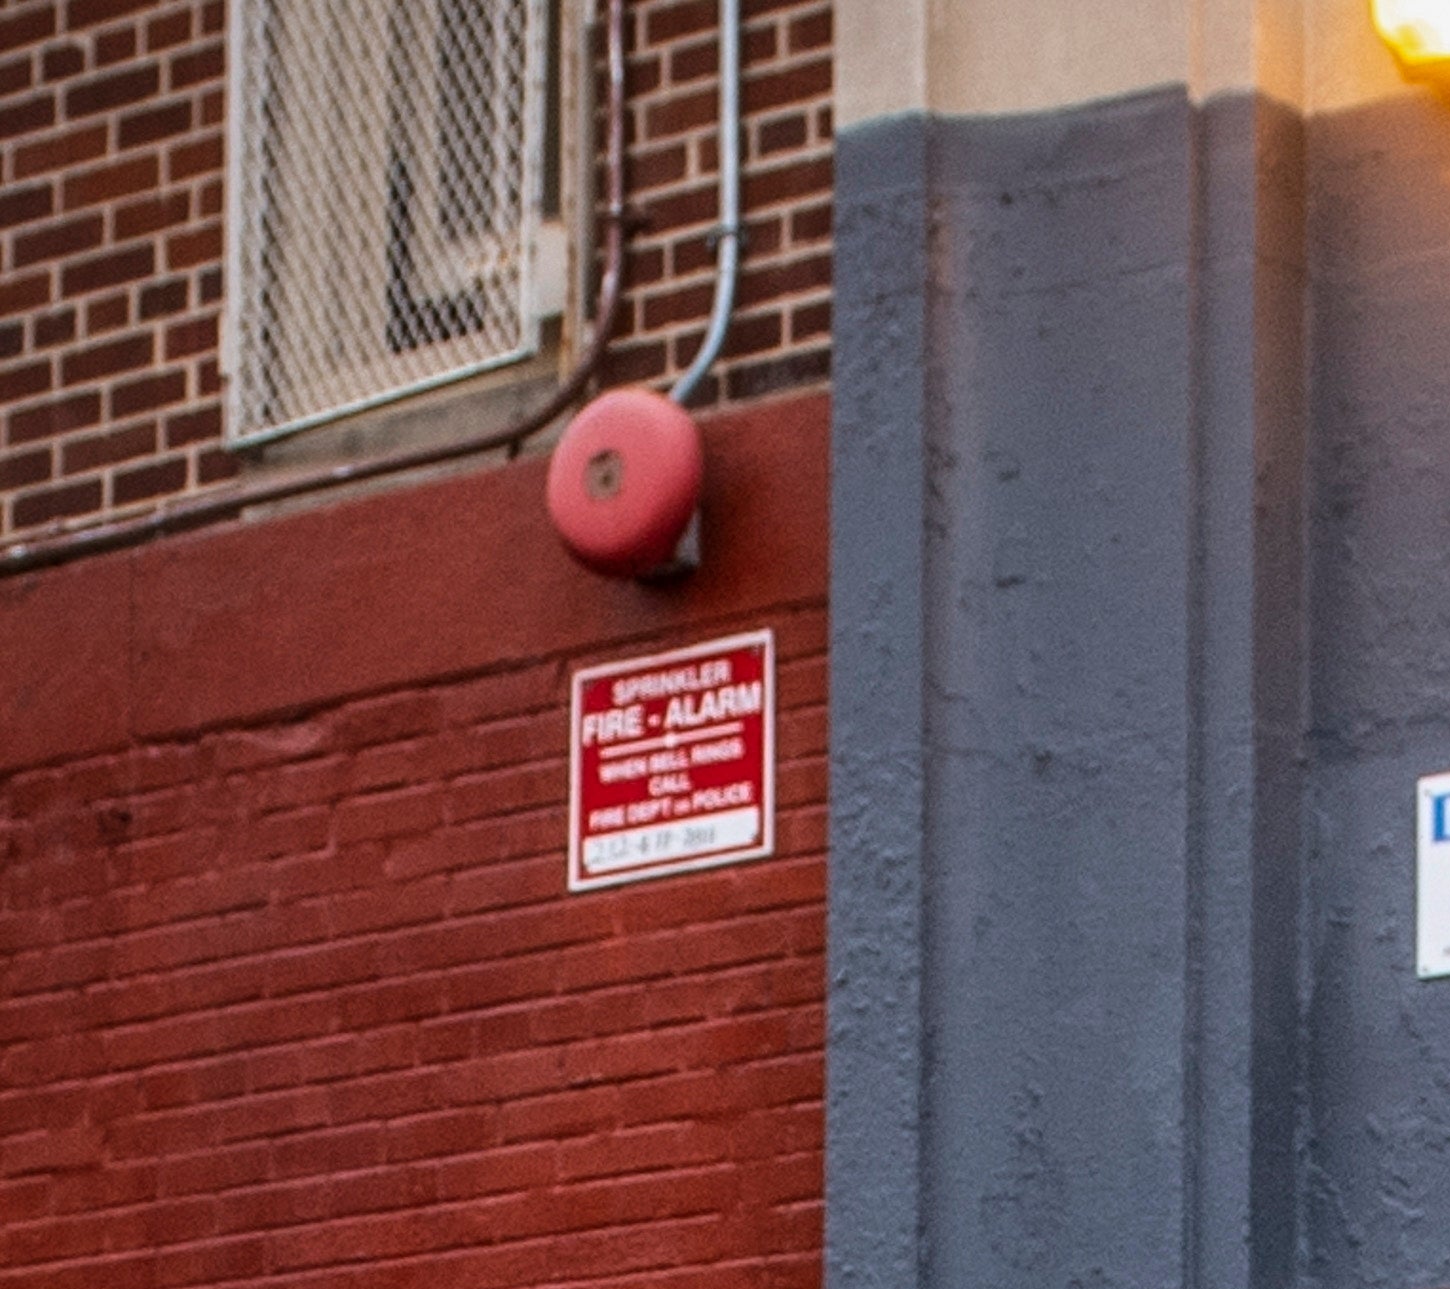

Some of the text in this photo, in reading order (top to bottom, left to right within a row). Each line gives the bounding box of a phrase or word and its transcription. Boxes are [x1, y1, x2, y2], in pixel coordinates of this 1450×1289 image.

[613, 659, 731, 706] SPRINKLER
[582, 705, 644, 746] FIRE
[664, 681, 762, 729] ALARM
[648, 773, 691, 797] CALL
